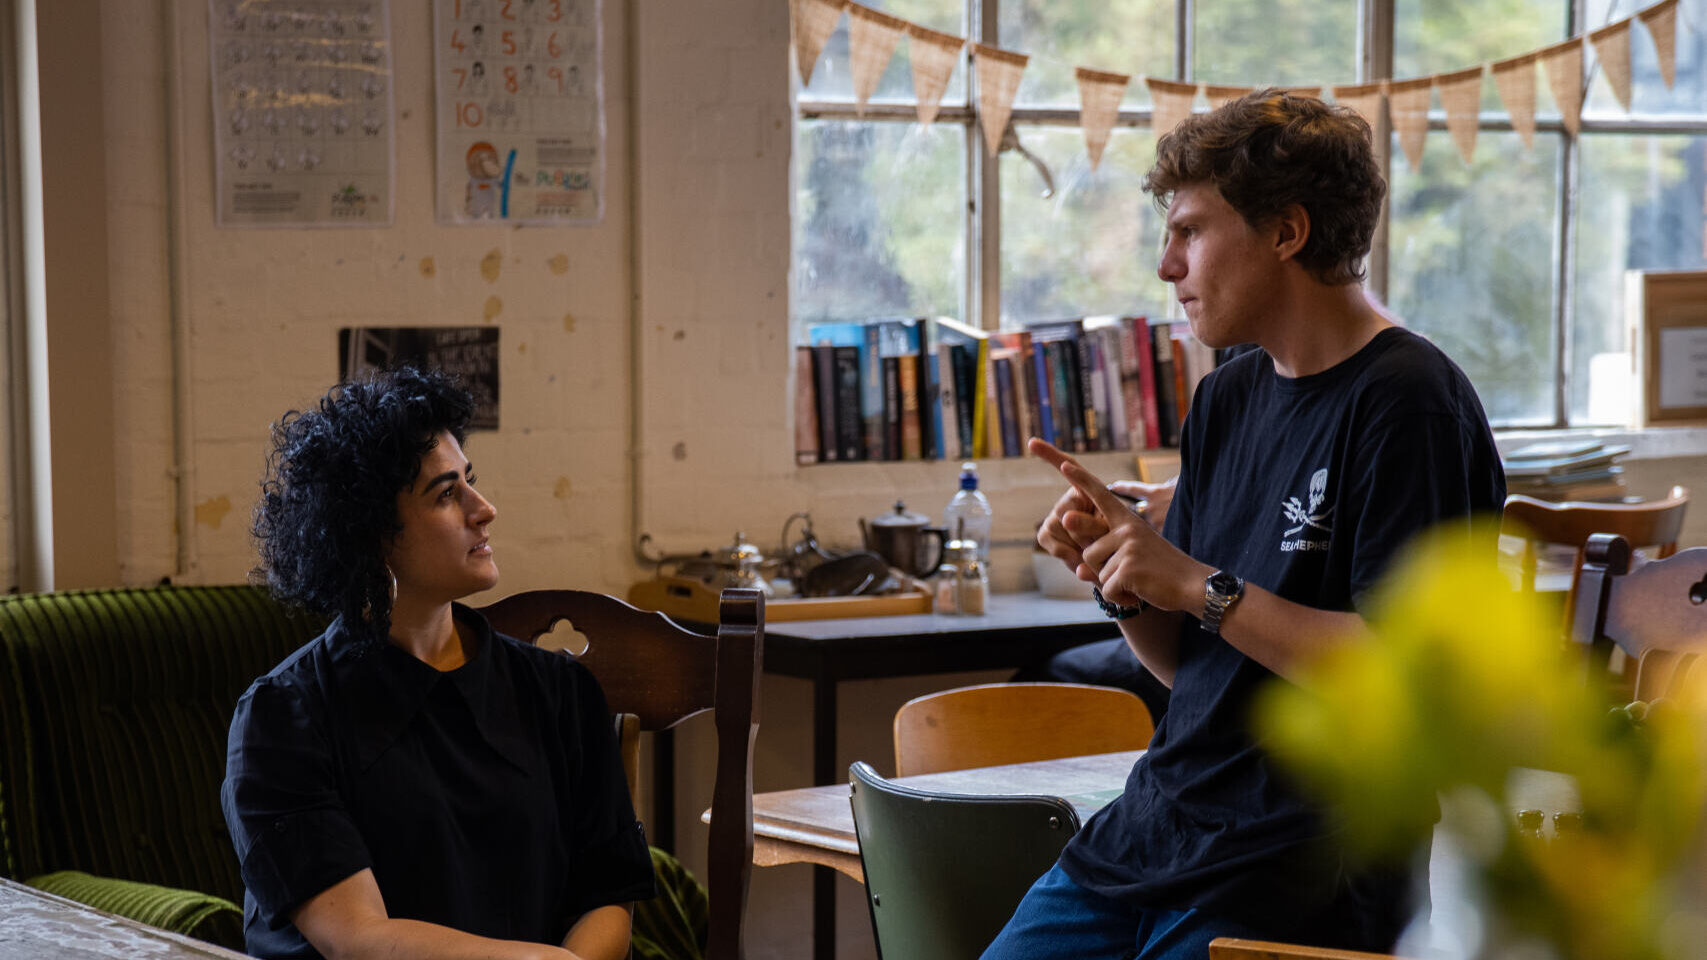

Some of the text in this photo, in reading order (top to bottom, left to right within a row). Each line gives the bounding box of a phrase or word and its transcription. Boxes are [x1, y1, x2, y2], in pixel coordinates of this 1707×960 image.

[501, 0, 516, 20] 2
[548, 0, 561, 22] 3
[451, 30, 561, 58] 4 5 6
[453, 66, 562, 94] 7 8 9
[456, 102, 483, 128] 10
